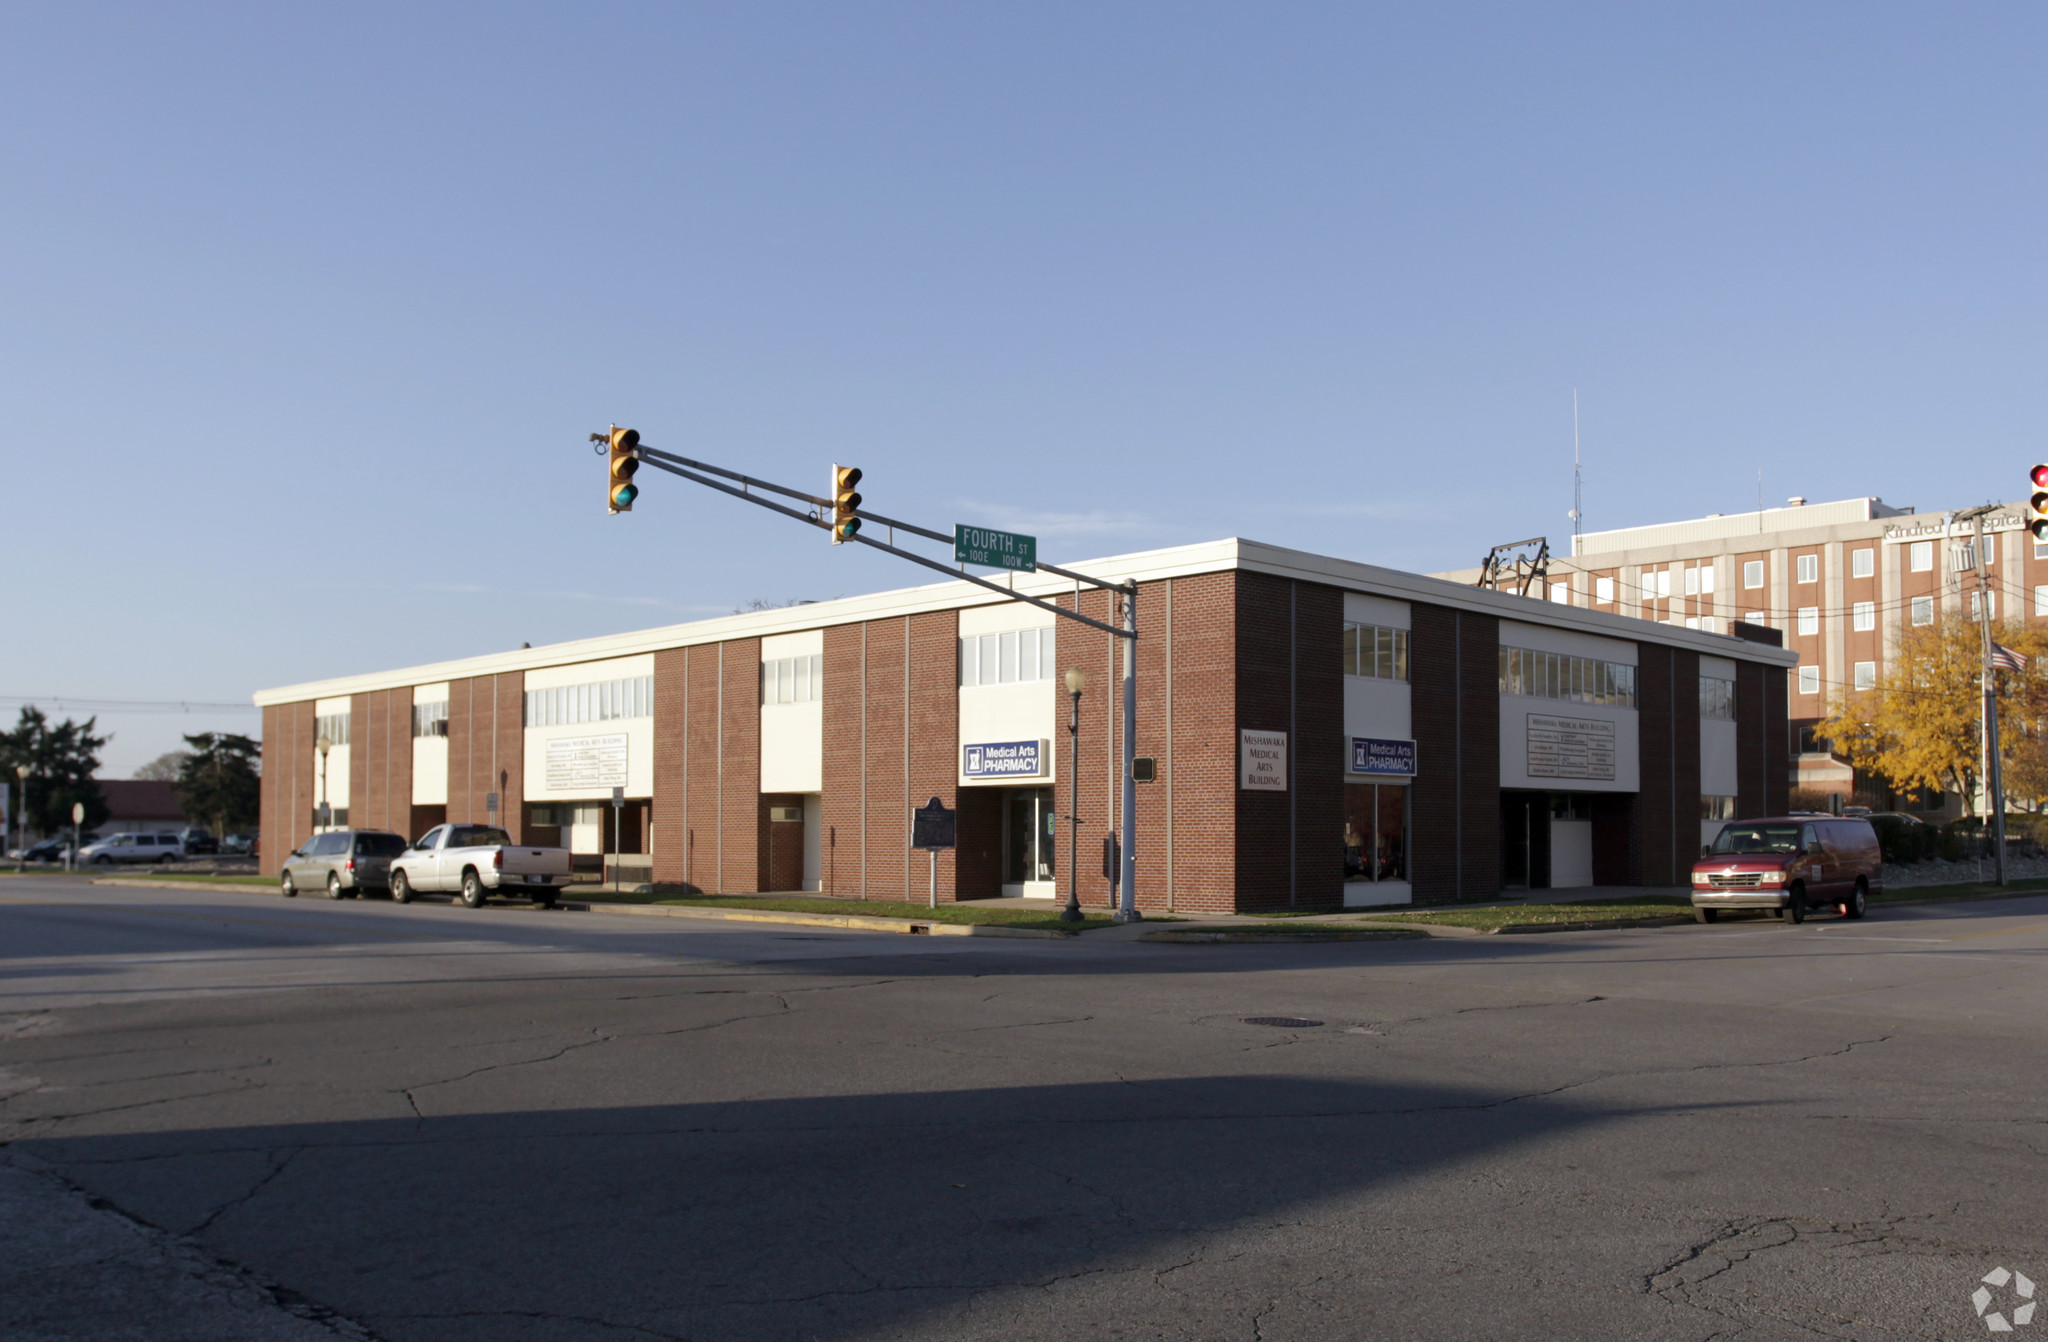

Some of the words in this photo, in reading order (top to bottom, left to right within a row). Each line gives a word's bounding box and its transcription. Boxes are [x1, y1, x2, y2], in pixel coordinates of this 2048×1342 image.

[1883, 518, 1944, 539] Kindred
[963, 528, 1013, 552] FOURTH
[1018, 543, 1028, 554] ST
[969, 550, 989, 563] 100E
[1002, 554, 1022, 567] 100W
[1244, 735, 1285, 746] MISHAWAKA
[986, 746, 1017, 758] Medical
[1019, 746, 1035, 757] Arts
[1250, 748, 1279, 760] MEDICAL
[1370, 743, 1396, 756] Medical
[1397, 745, 1411, 756] Arts
[984, 758, 1037, 772] PHARMACY
[1256, 761, 1273, 772] ARTS
[1368, 756, 1413, 770] PHARMACY
[1248, 774, 1281, 786] BUILDING
